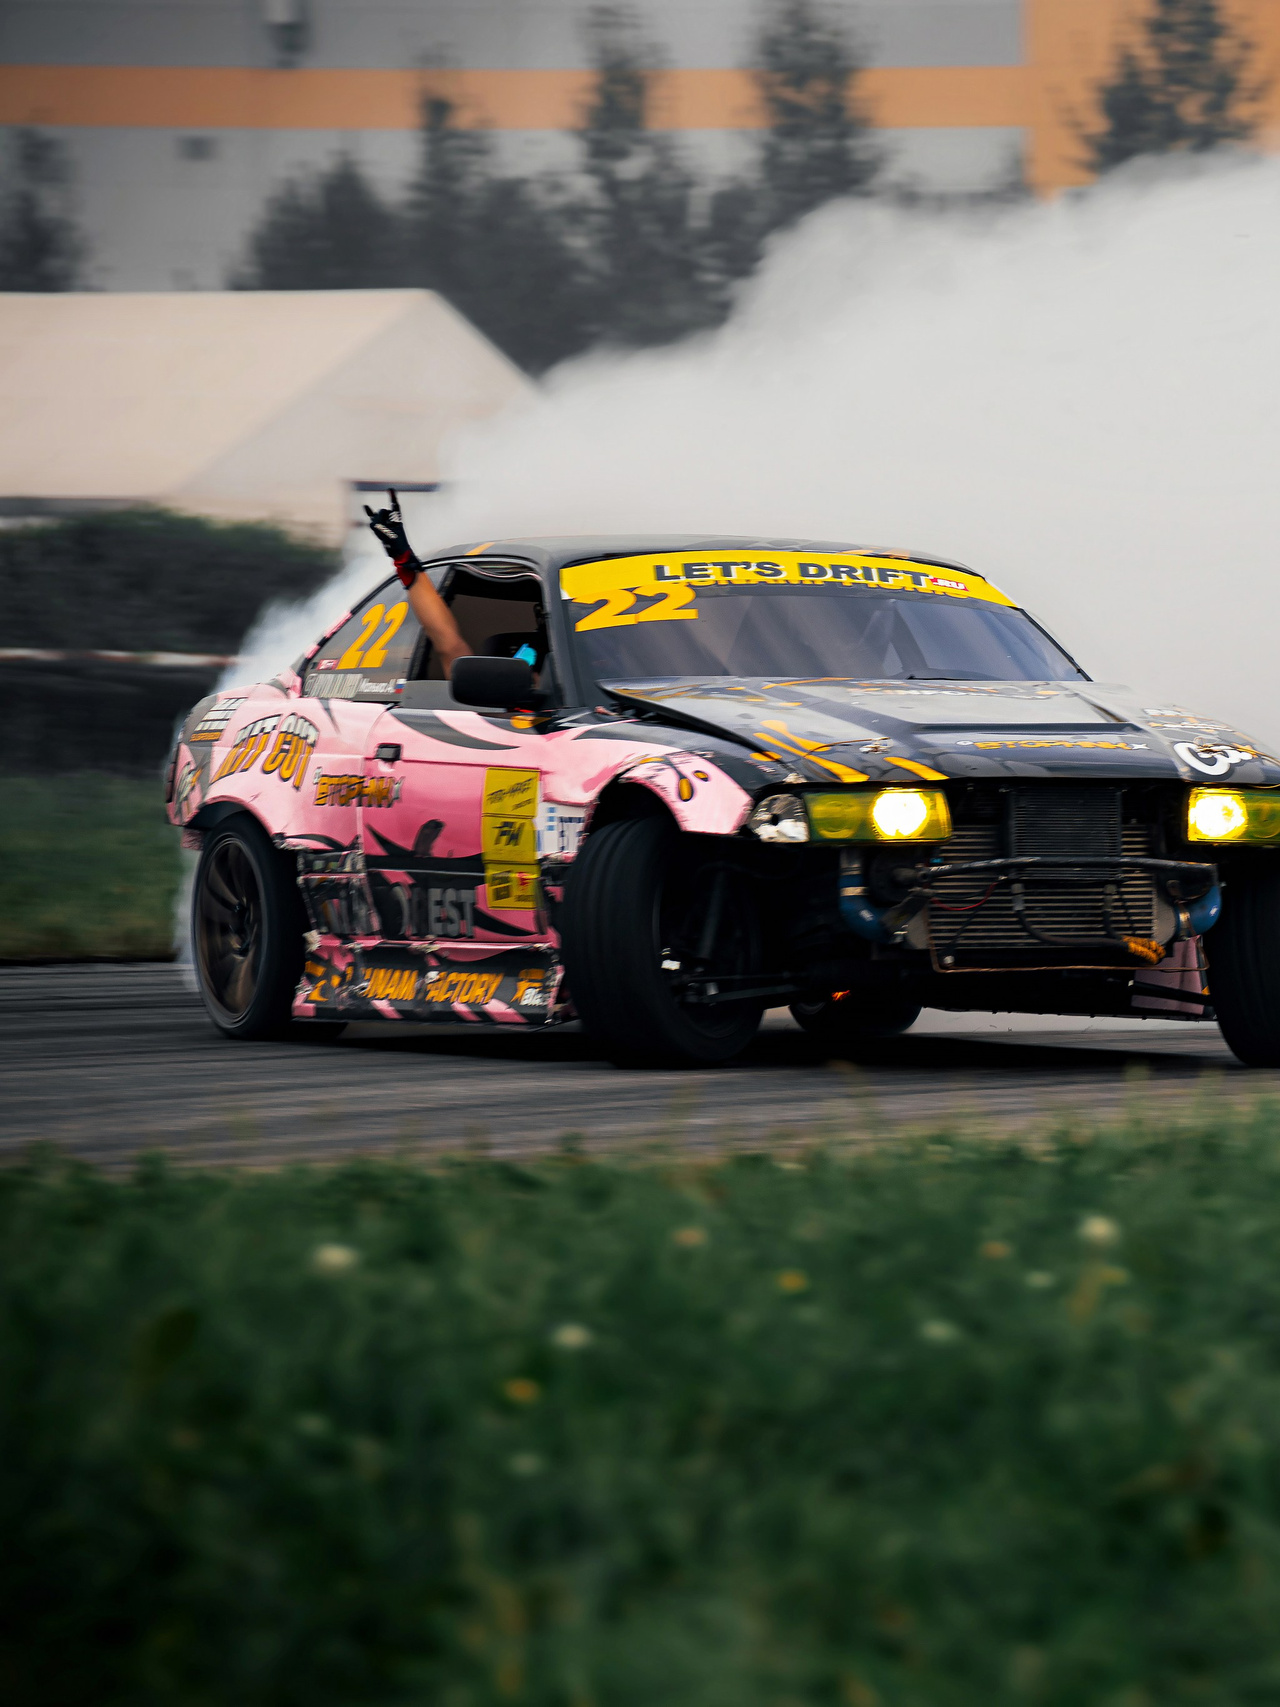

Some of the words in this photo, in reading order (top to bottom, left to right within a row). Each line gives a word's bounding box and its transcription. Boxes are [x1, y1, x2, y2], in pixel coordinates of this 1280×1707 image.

[655, 562, 783, 581] LET'S
[573, 584, 698, 632] 22
[337, 602, 409, 669] 22
